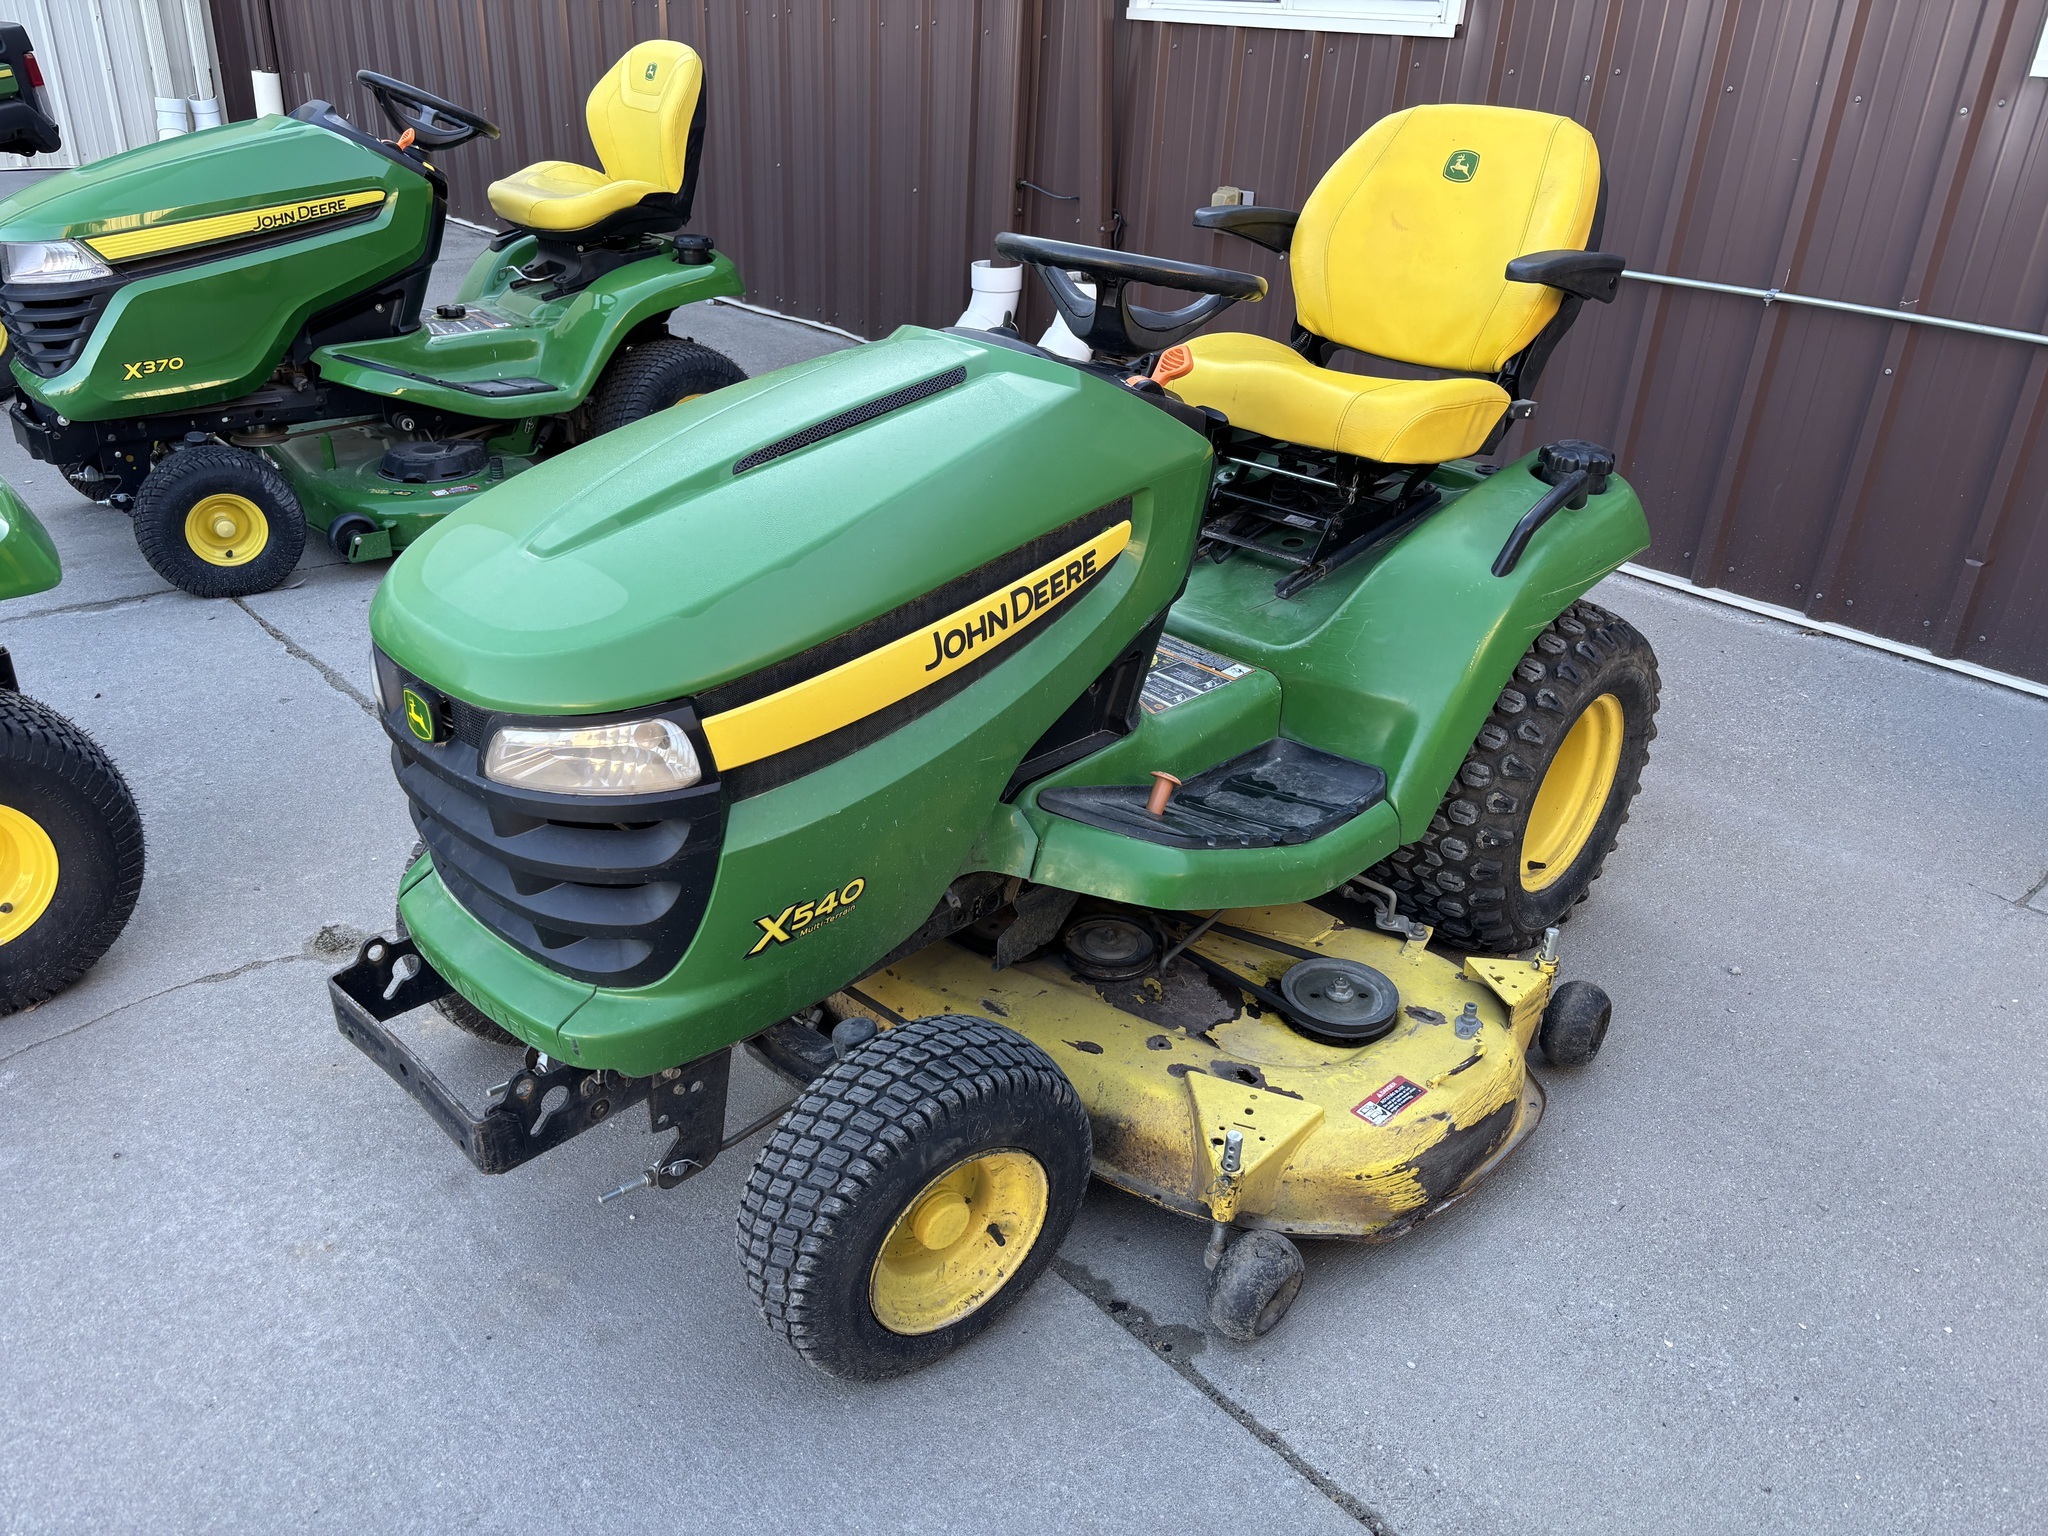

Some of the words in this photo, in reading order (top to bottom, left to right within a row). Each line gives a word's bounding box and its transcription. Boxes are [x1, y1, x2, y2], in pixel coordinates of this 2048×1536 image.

[253, 211, 294, 230] JOHN
[297, 200, 347, 219] DEERE
[121, 356, 185, 381] X370
[925, 603, 1009, 672] JOHN
[1010, 549, 1097, 624] DEERE
[743, 876, 866, 960] X540
[799, 904, 856, 938] Multi-Terrain
